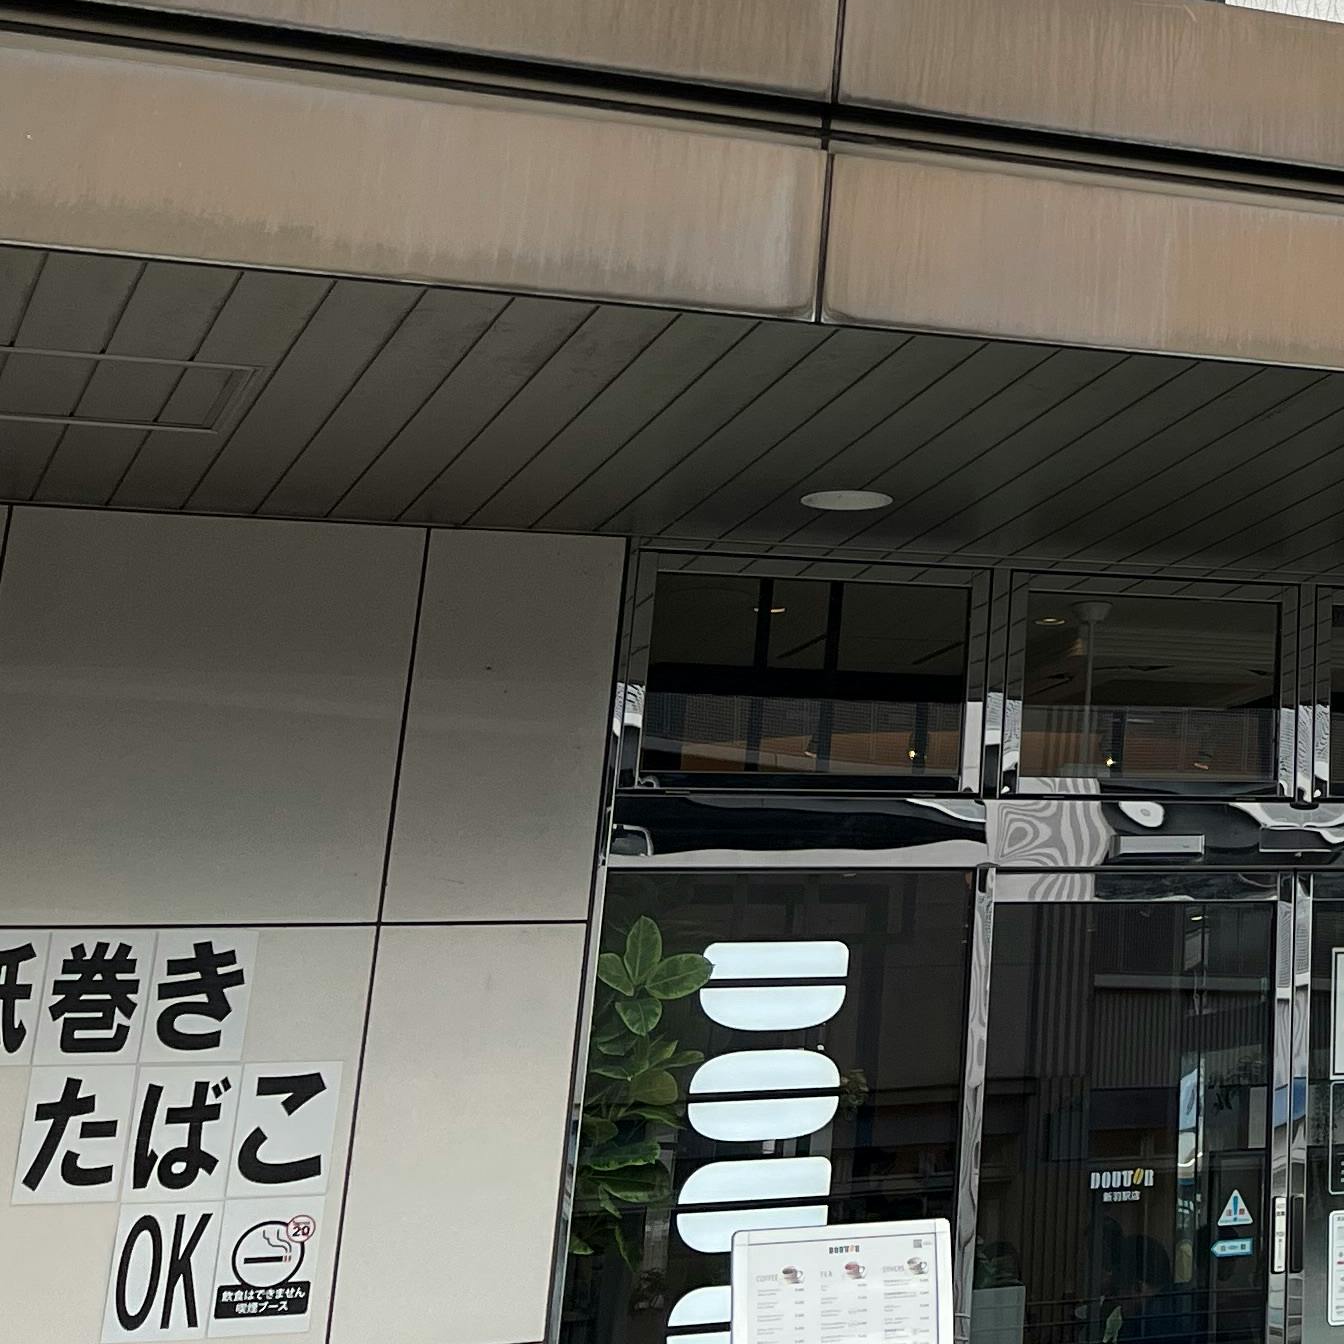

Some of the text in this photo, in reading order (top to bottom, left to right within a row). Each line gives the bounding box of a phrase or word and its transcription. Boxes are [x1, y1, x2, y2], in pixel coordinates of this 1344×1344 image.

[22, 1072, 327, 1192] たばこ
[1090, 1167, 1154, 1189] DOUTOR
[292, 1225, 310, 1237] 20
[115, 1212, 213, 1331] OK
[221, 1287, 306, 1302] 飲食はできません
